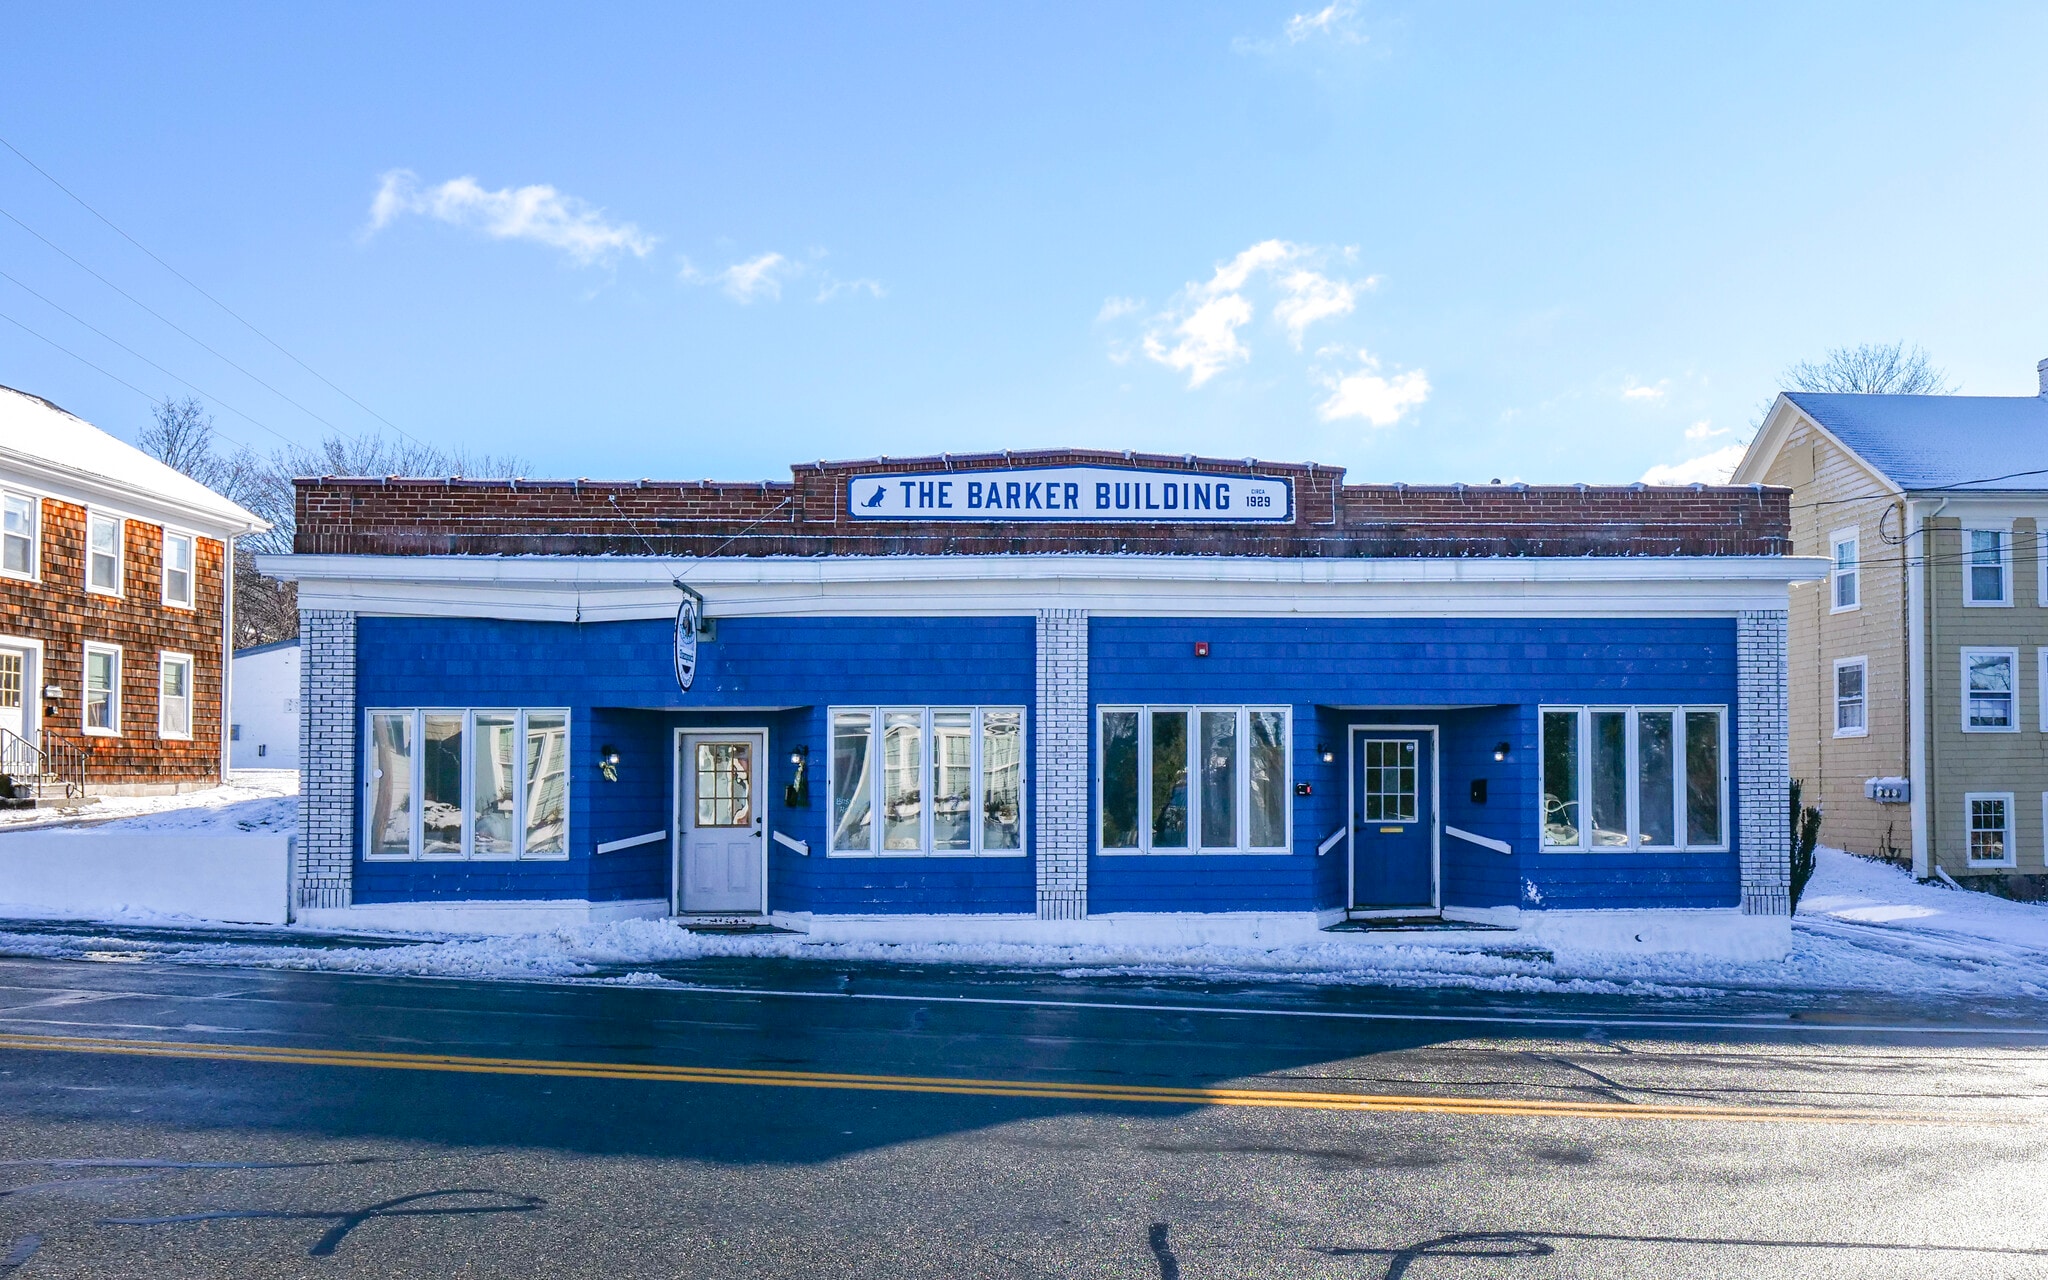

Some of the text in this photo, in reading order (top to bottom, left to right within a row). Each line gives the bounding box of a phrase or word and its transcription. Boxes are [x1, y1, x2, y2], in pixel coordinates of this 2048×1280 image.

[900, 481, 1230, 510] THE BARKER BUILDING
[1246, 496, 1271, 507] 1929
